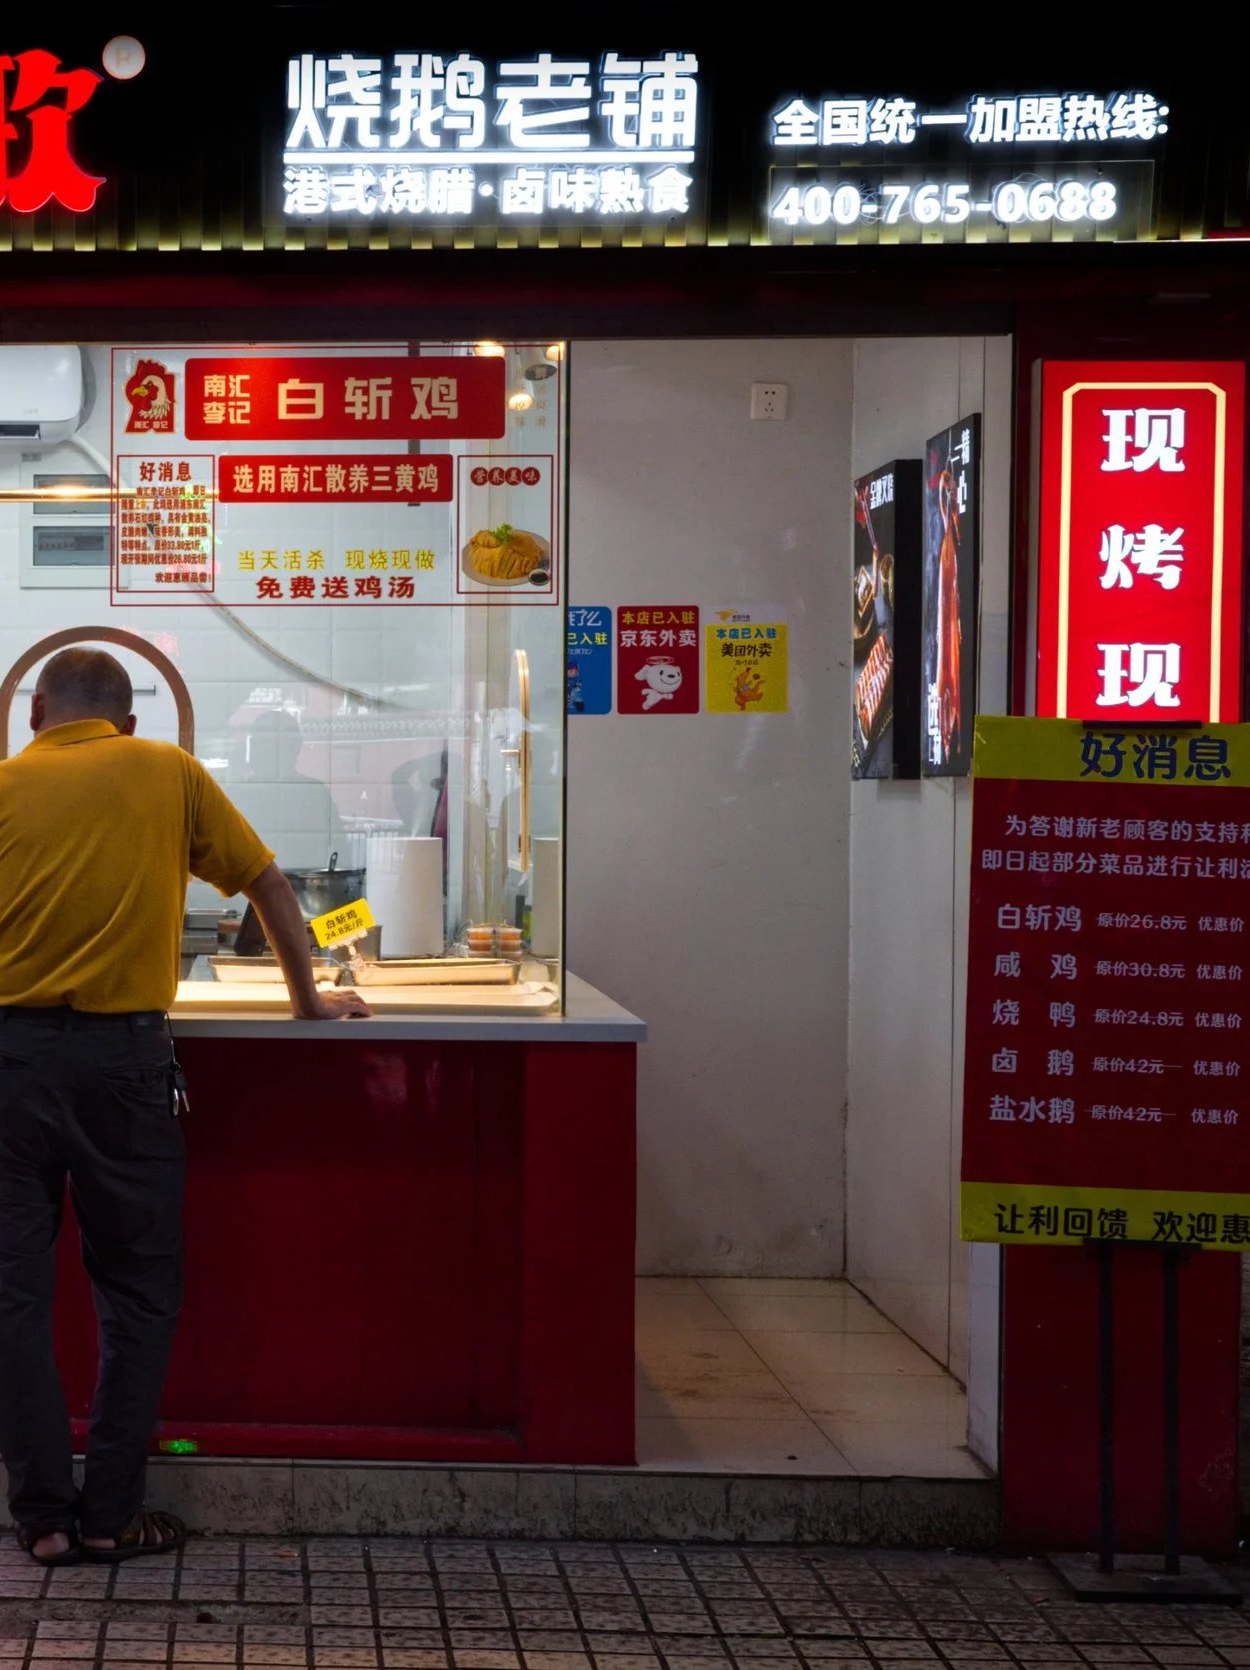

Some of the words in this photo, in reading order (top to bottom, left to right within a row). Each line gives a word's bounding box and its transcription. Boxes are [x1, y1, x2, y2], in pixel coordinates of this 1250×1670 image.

[285, 53, 699, 150] 烧鹅老铺
[771, 180, 1118, 226] 400-765-0688
[203, 375, 251, 398] 南汇
[277, 377, 459, 421] 白斩鸡
[139, 461, 192, 482] 好消息
[232, 463, 440, 495] 选用南汇散养三黄鸡
[237, 549, 326, 571] 当天活杀
[345, 549, 436, 571] 现烧现做
[1096, 407, 1187, 707] 现烤现
[256, 575, 416, 600] 免费送鸡汤
[622, 610, 696, 625] 本店已入驻
[620, 629, 697, 648] 京东外卖
[721, 642, 773, 658] 美团外卖
[1079, 731, 1231, 781] 好消息
[325, 909, 358, 930] 白斩鸡
[997, 902, 1082, 932] 白斩鸡
[1198, 915, 1245, 933] 优惠价
[1196, 964, 1243, 980] 优惠价
[1194, 1011, 1243, 1029] 优惠价
[1192, 1060, 1241, 1077] 优惠价
[989, 1094, 1075, 1124] 盐水鹅
[1190, 1108, 1239, 1125] 优惠价
[994, 1202, 1129, 1240] 让利回馈
[1151, 1210, 1250, 1245] 欢迎惠
